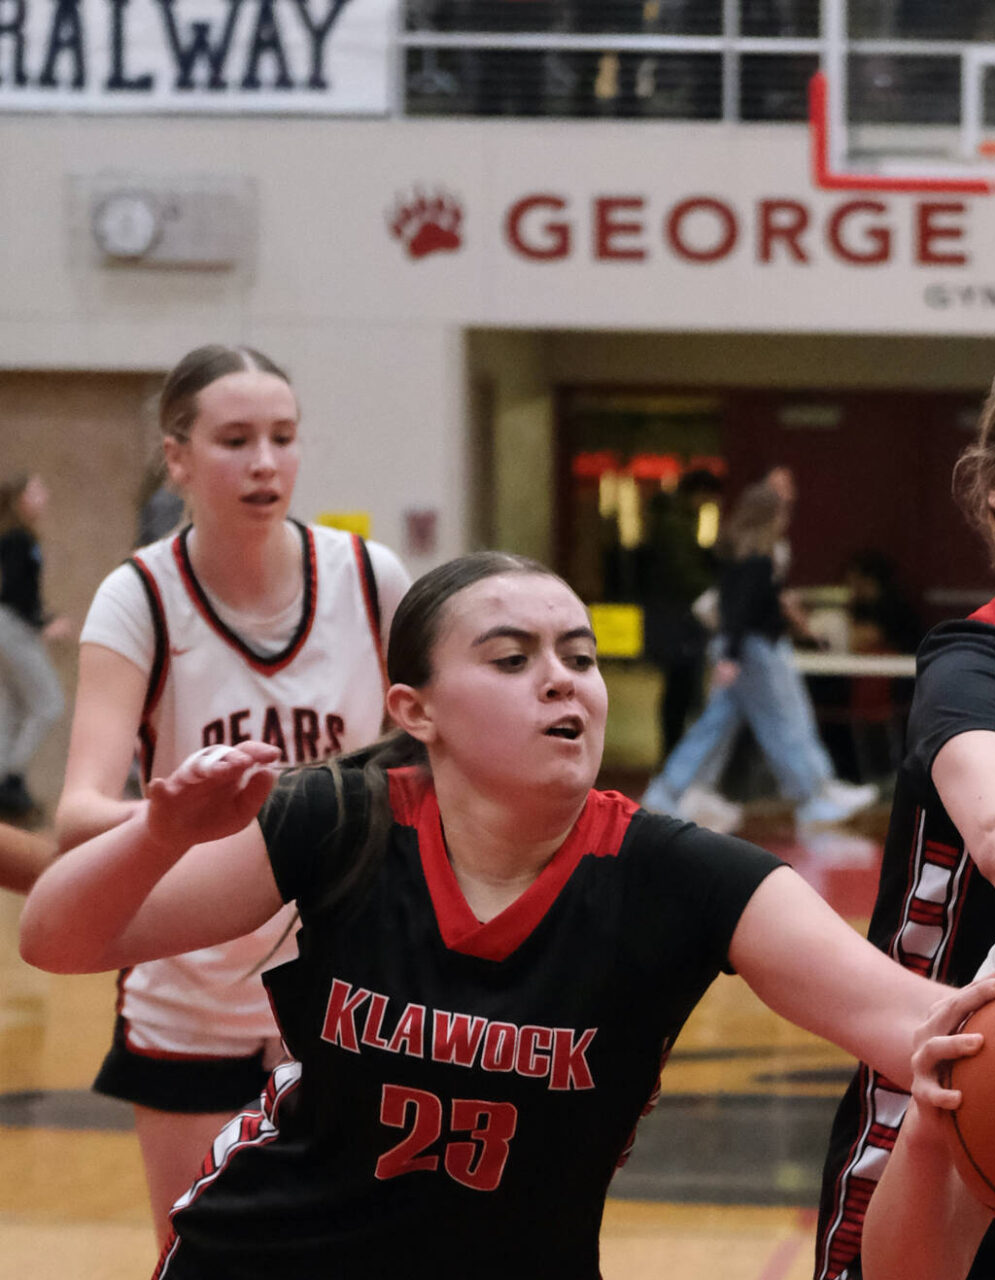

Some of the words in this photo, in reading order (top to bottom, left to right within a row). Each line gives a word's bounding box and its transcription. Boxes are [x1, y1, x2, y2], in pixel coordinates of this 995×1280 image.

[505, 195, 970, 267] GEORGE
[320, 977, 599, 1091] KLAWOCK
[374, 1084, 518, 1192] 23
